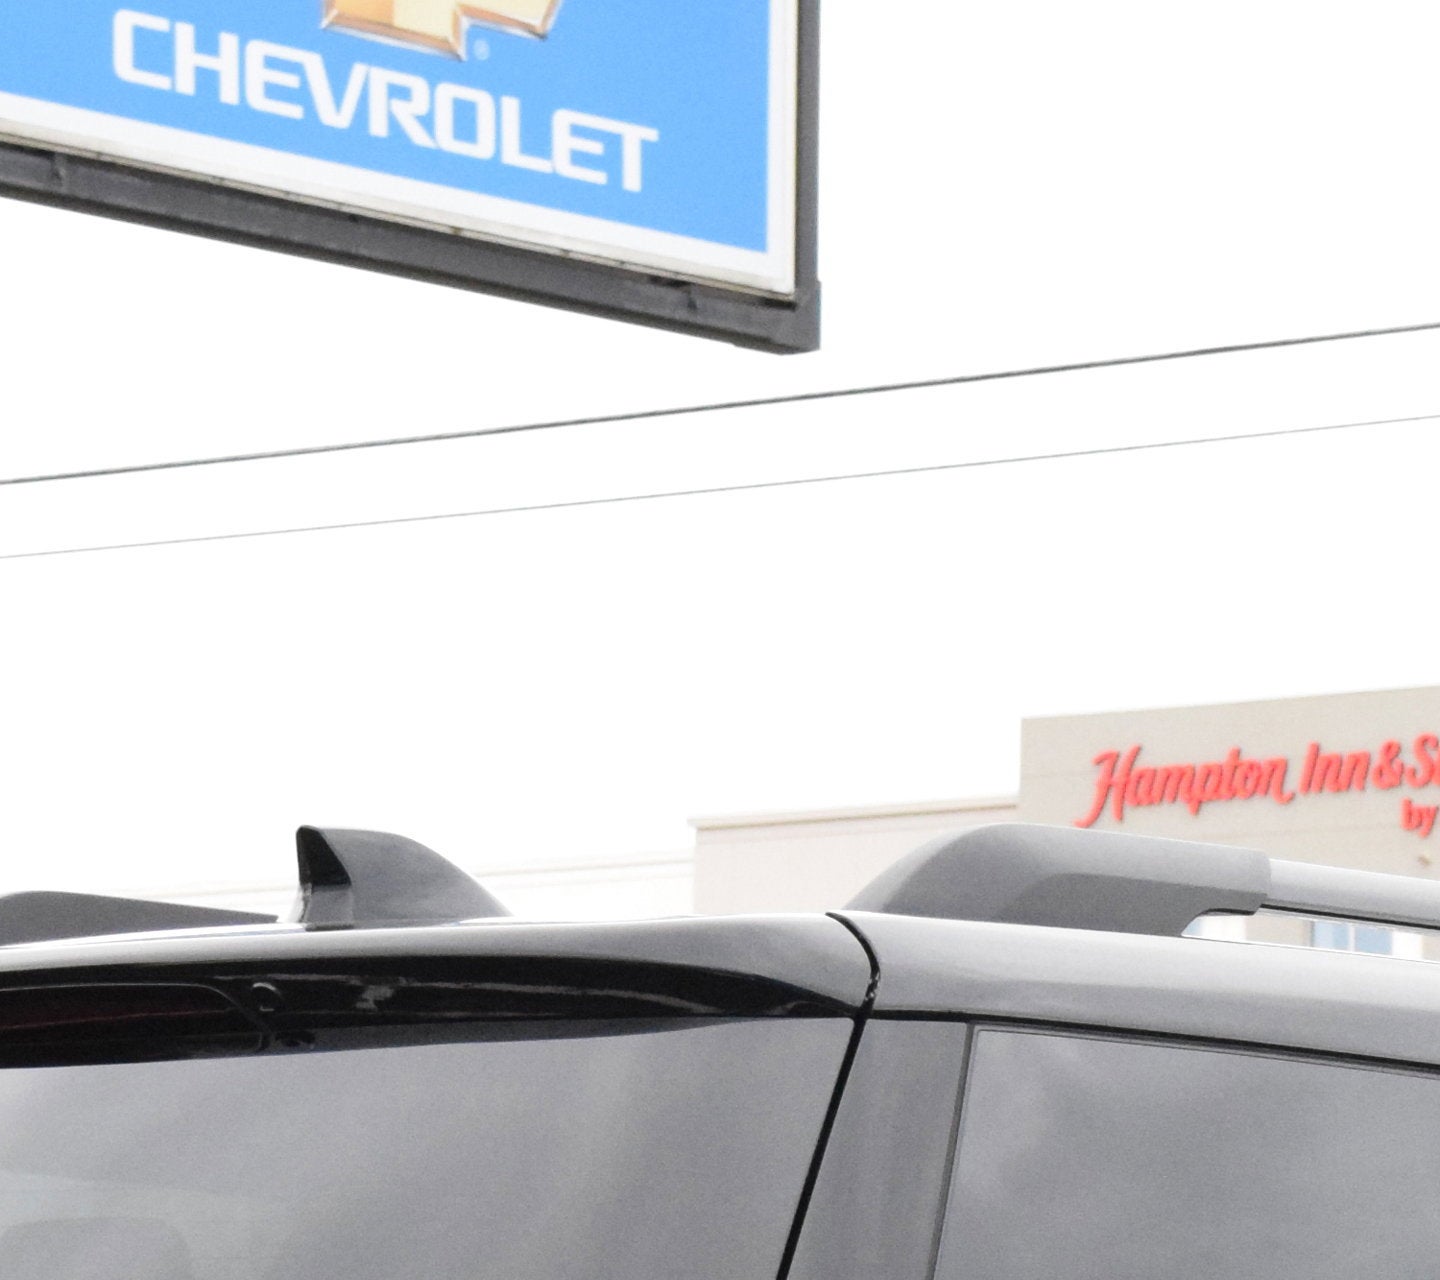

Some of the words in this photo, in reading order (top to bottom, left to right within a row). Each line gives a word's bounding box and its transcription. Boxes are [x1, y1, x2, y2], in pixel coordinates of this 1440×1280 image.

[112, 9, 660, 193] CHEVROLET
[1073, 744, 1295, 829] Hampton
[1401, 797, 1440, 838] by
